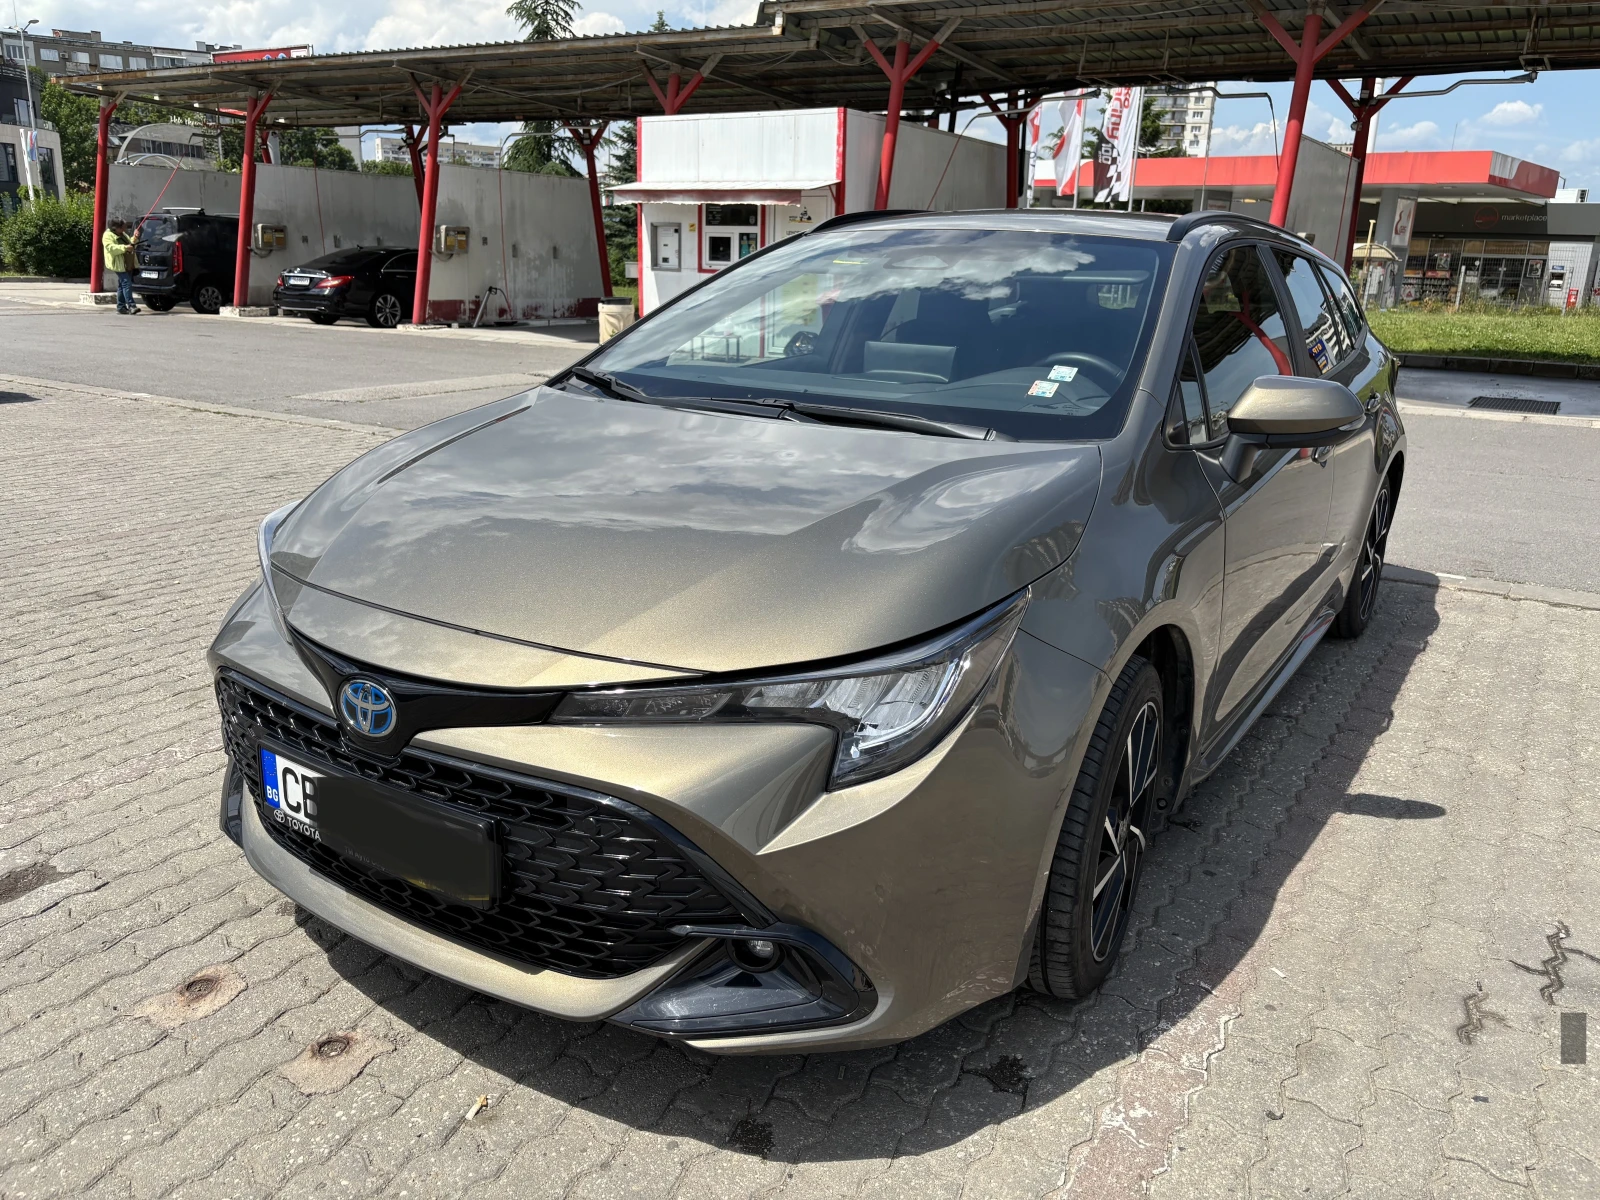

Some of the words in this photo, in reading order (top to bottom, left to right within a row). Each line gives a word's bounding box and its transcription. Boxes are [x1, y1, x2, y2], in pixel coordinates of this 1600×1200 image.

[1101, 143, 1112, 165] 100
[1501, 213, 1548, 222] marketplace
[266, 785, 279, 802] BG
[287, 816, 321, 841] TOYOTA
